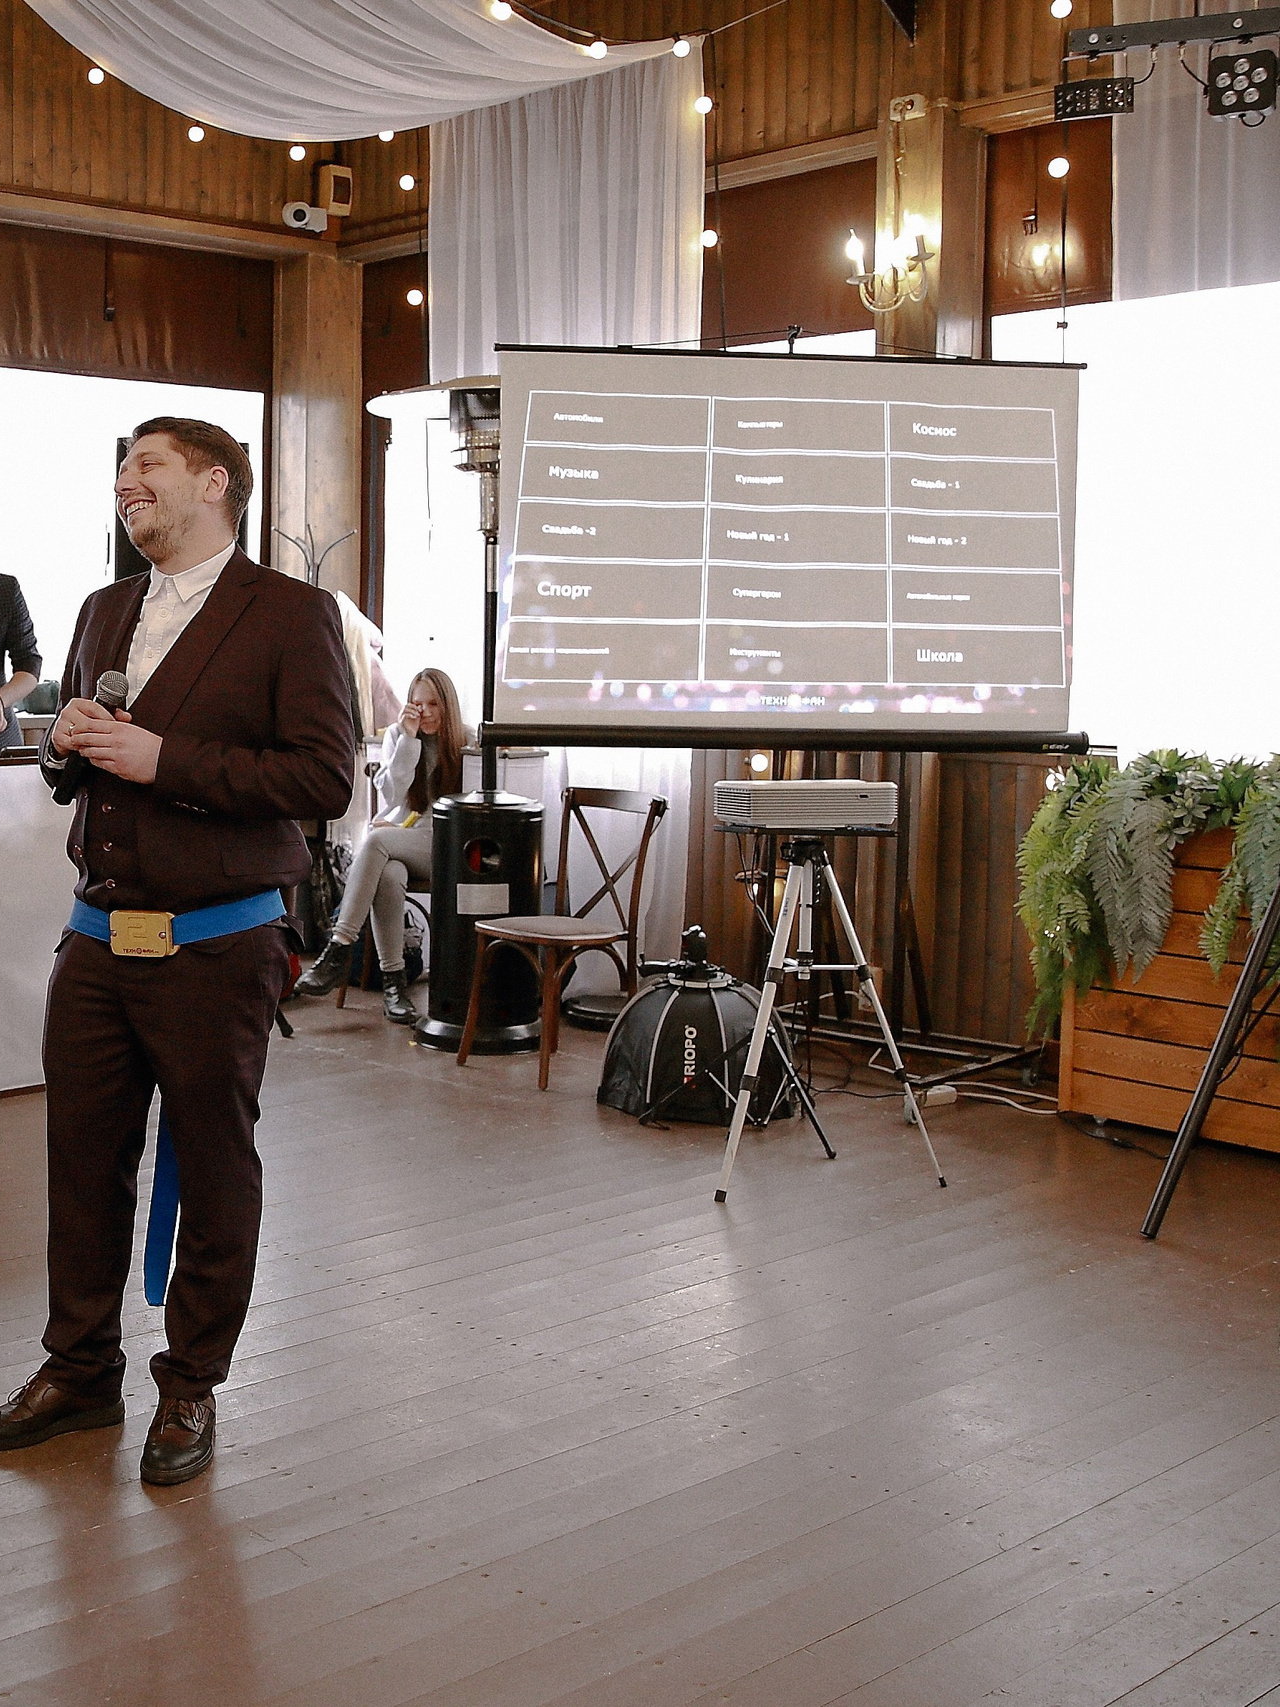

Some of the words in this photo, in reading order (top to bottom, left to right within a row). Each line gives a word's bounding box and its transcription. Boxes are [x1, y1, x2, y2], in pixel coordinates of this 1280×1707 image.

[912, 422, 957, 437] Космос
[548, 465, 600, 480] Музыка
[910, 478, 947, 489] Свадьба
[541, 524, 584, 536] Свадьба
[726, 529, 758, 541] Новый
[907, 534, 936, 545] Новый
[537, 581, 592, 600] Спорт
[916, 648, 964, 663] Школа
